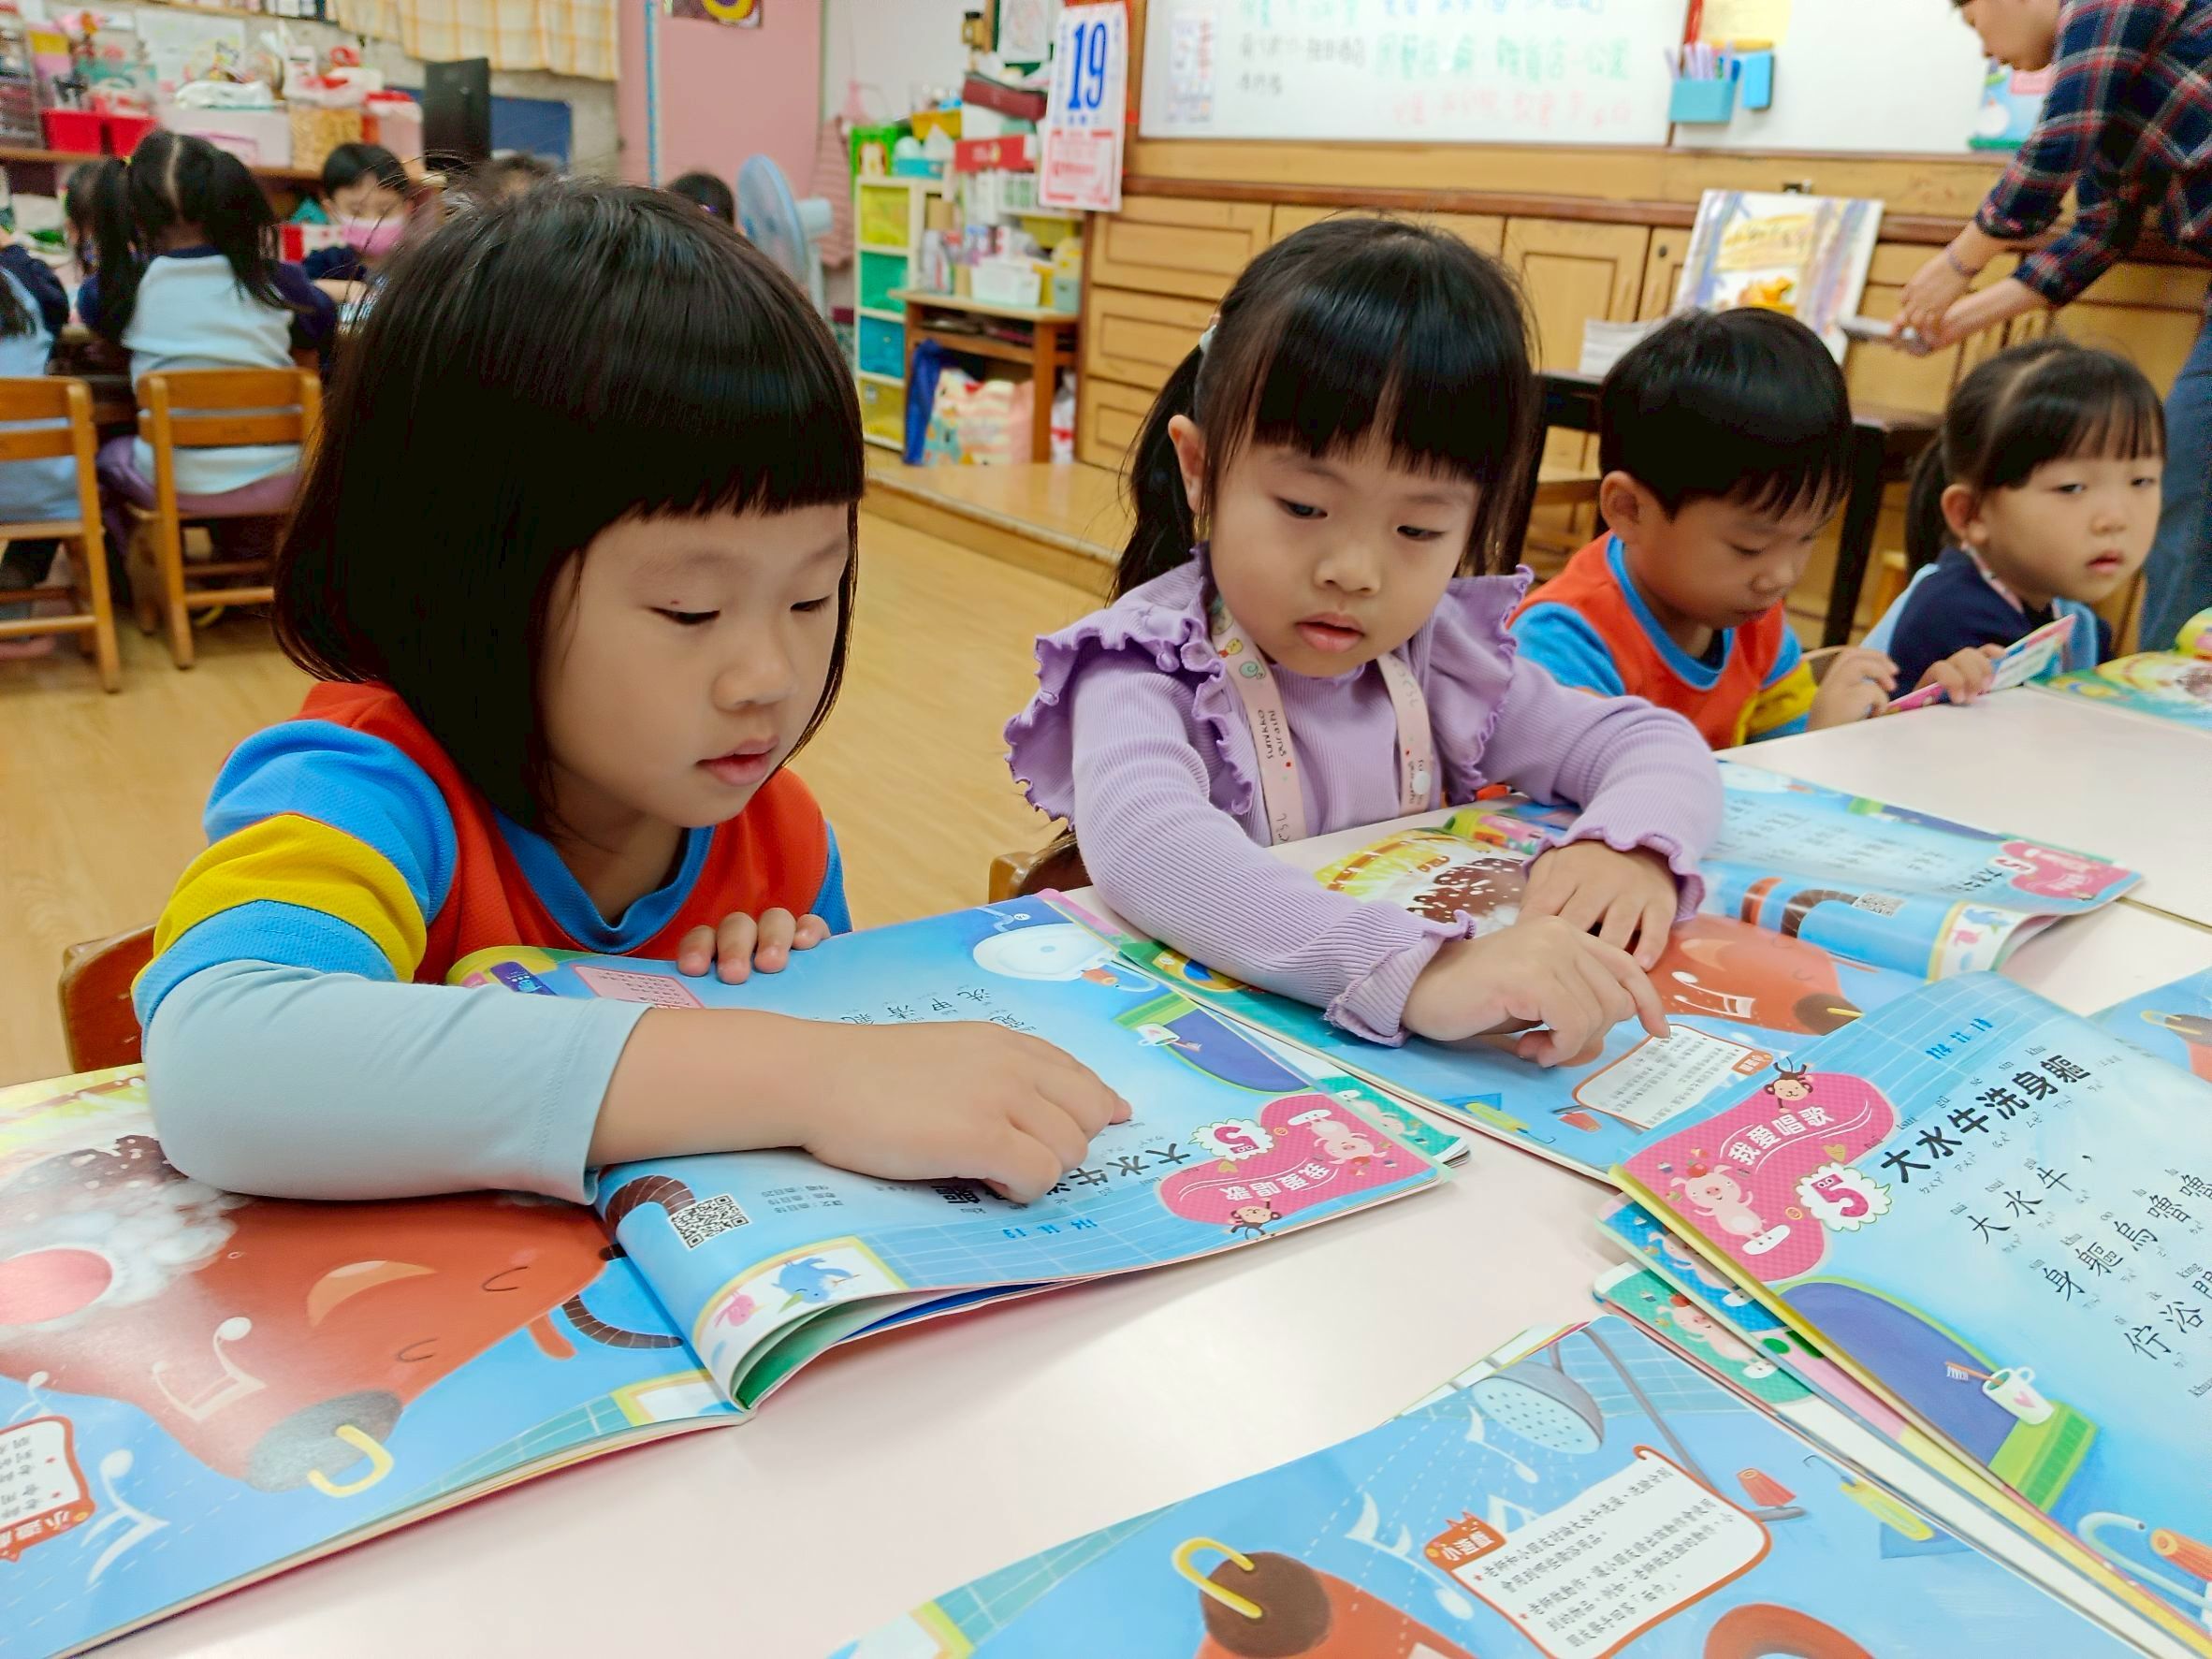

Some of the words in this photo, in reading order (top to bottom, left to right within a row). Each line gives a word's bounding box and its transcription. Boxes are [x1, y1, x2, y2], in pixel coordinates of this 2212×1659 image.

[1068, 22, 1107, 109] 19
[1214, 1126, 1259, 1155] 5
[1728, 1106, 1835, 1166] 我愛唱歌
[1880, 1055, 2091, 1184] 大水牛洗身軀
[1218, 1161, 1330, 1201] 我愛唱歌
[1811, 1173, 1870, 1217] 5
